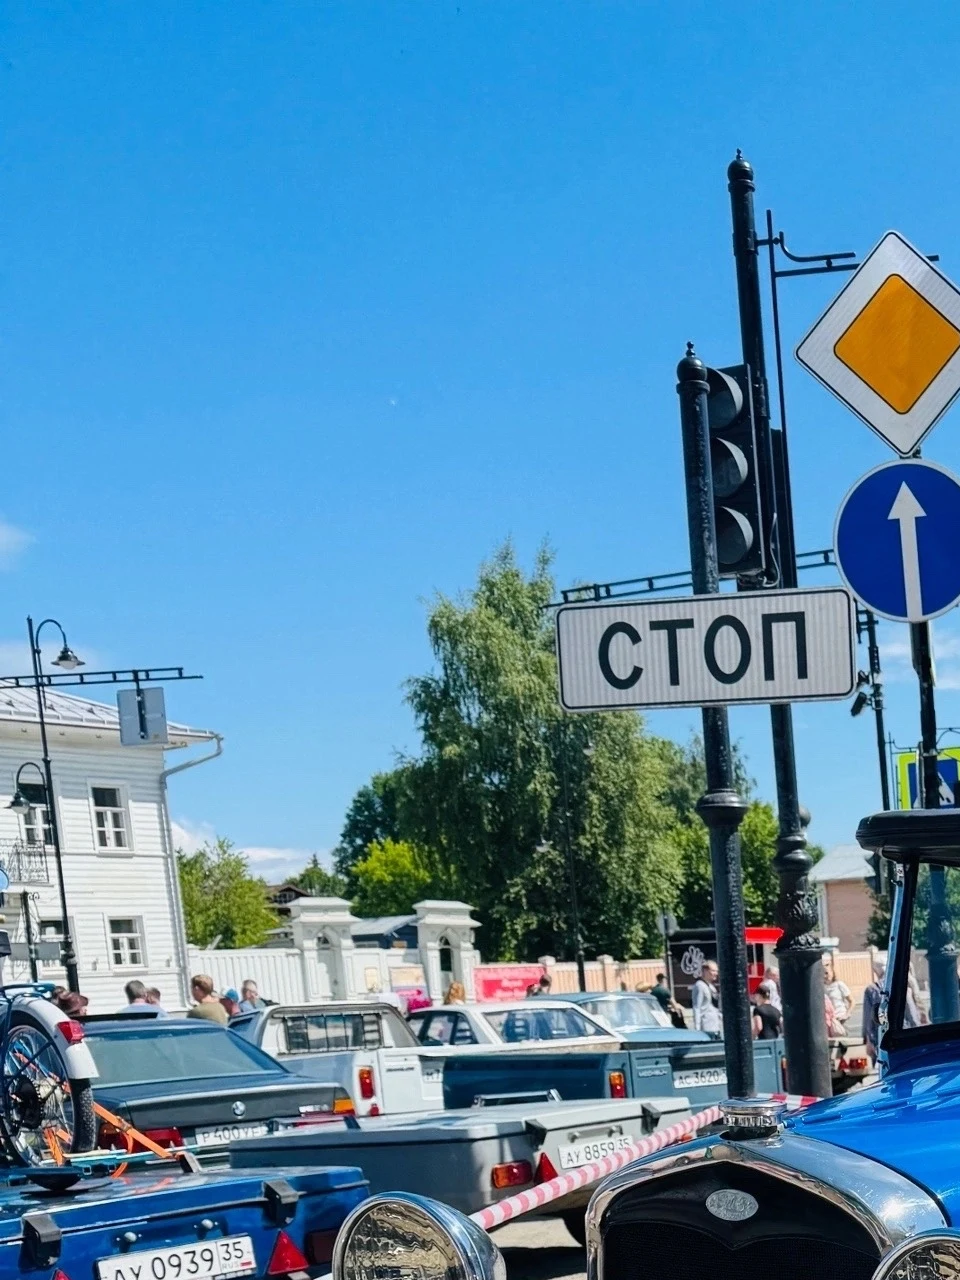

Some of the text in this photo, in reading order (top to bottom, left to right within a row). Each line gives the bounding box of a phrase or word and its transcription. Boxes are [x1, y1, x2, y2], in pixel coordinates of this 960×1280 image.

[598, 611, 808, 690] СТОП
[693, 1069, 720, 1085] 3620
[566, 1150, 580, 1165] АУ
[584, 1141, 615, 1161] 8859
[151, 1248, 214, 1280] 0939
[219, 1241, 244, 1261] 35
